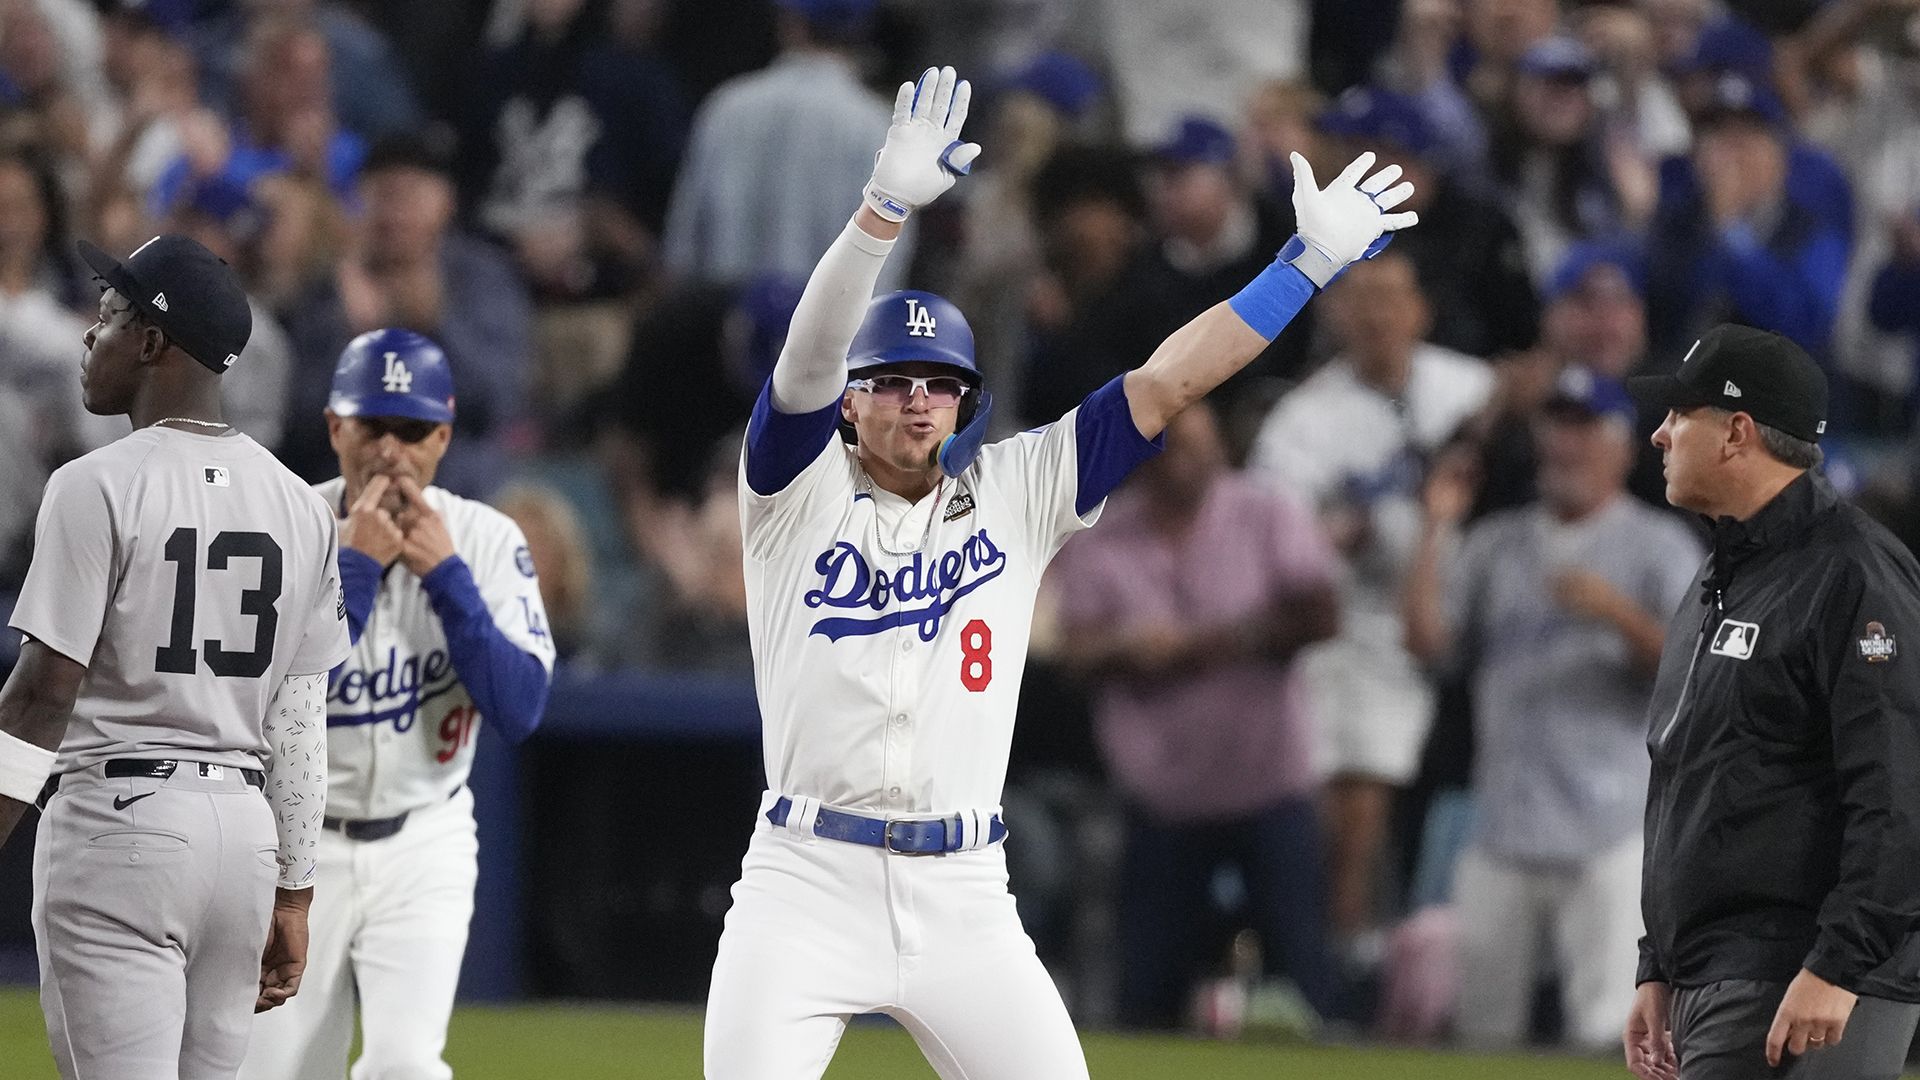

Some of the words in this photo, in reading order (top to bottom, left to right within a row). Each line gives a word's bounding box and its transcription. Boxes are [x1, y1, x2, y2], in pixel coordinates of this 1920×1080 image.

[905, 298, 936, 337] LA
[381, 351, 413, 393] LA
[154, 527, 283, 678] 13
[804, 528, 1006, 642] Dodgers
[960, 619, 992, 692] 8
[1859, 638, 1893, 648] WORLD
[1861, 647, 1893, 655] SERIES
[327, 645, 452, 733] odge
